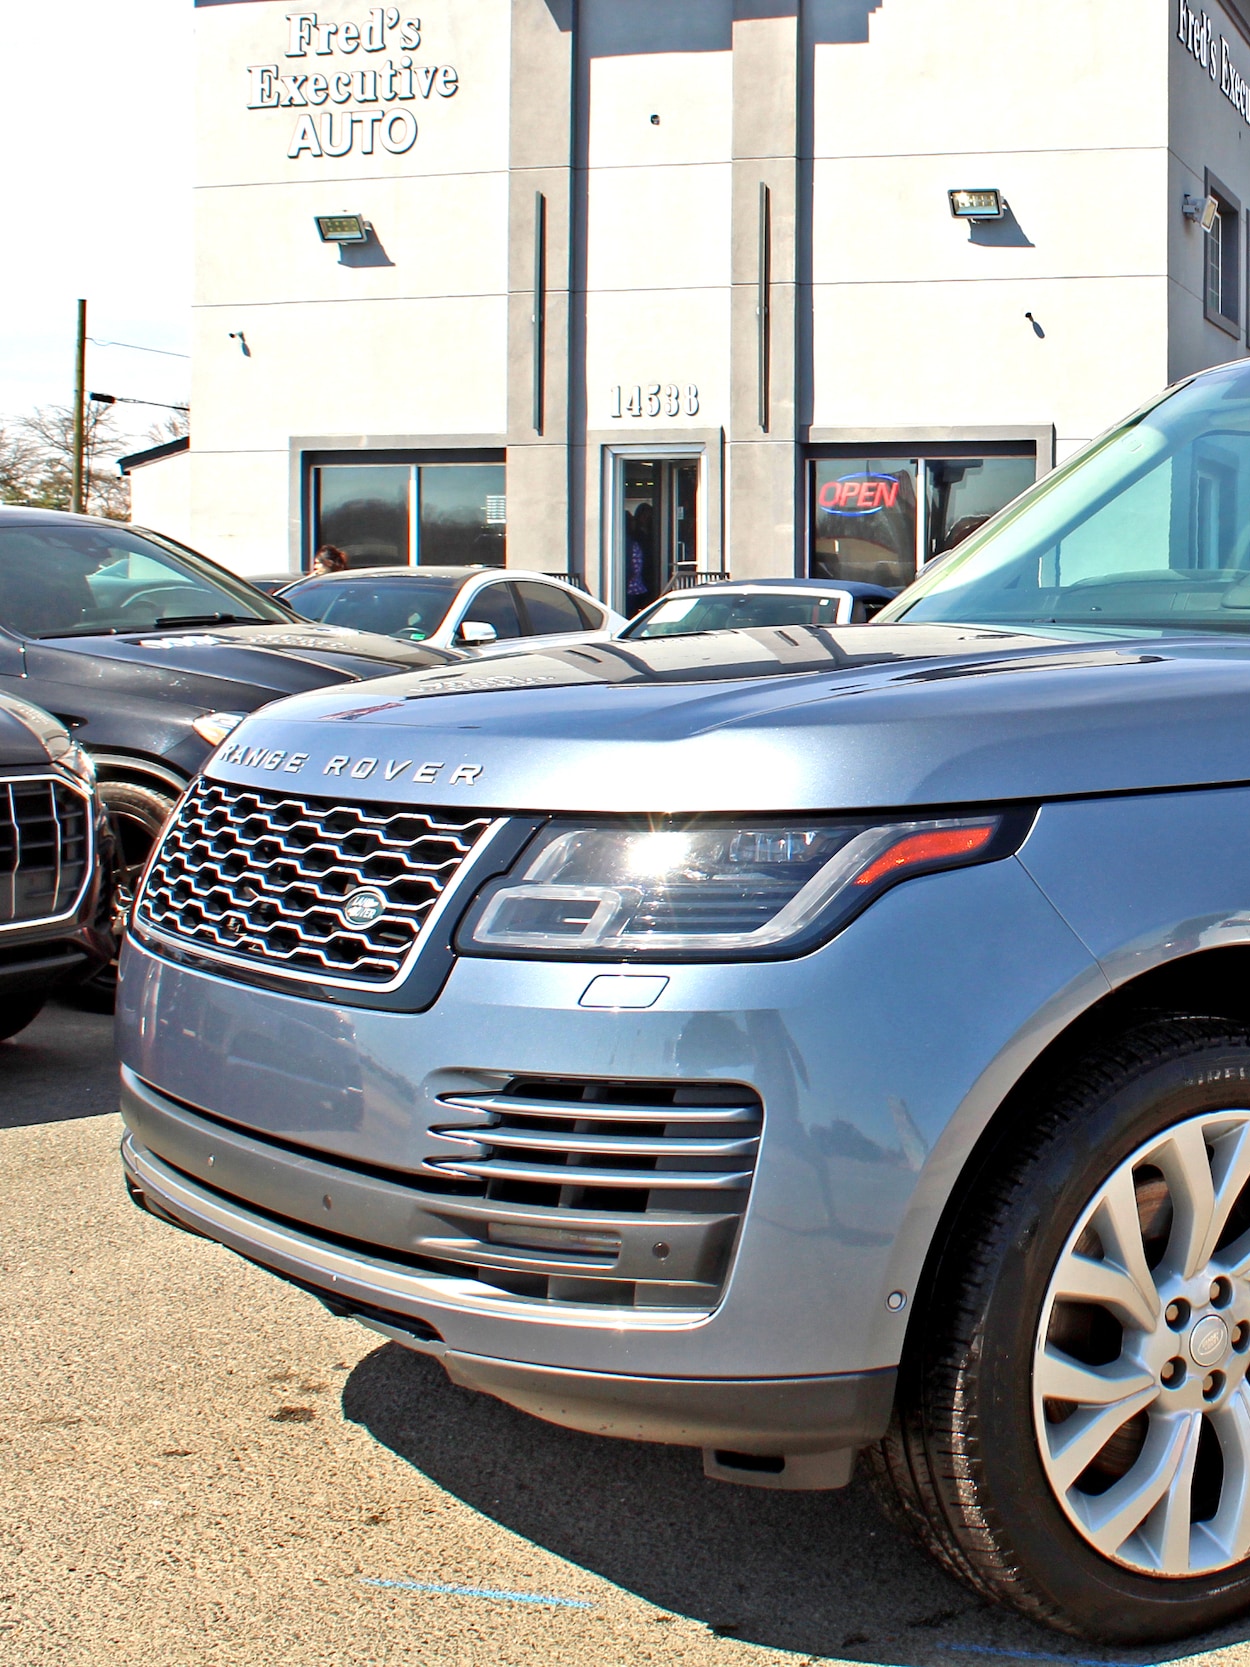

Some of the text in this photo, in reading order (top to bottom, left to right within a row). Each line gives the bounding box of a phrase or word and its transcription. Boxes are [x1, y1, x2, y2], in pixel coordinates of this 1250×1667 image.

[284, 7, 422, 57] Fred's
[1177, 0, 1217, 81] Fred's
[247, 55, 459, 109] Executive
[287, 107, 418, 159] AUTO
[610, 383, 700, 418] 14538
[818, 481, 899, 508] OPEN
[219, 743, 485, 786] RANGE ROVER
